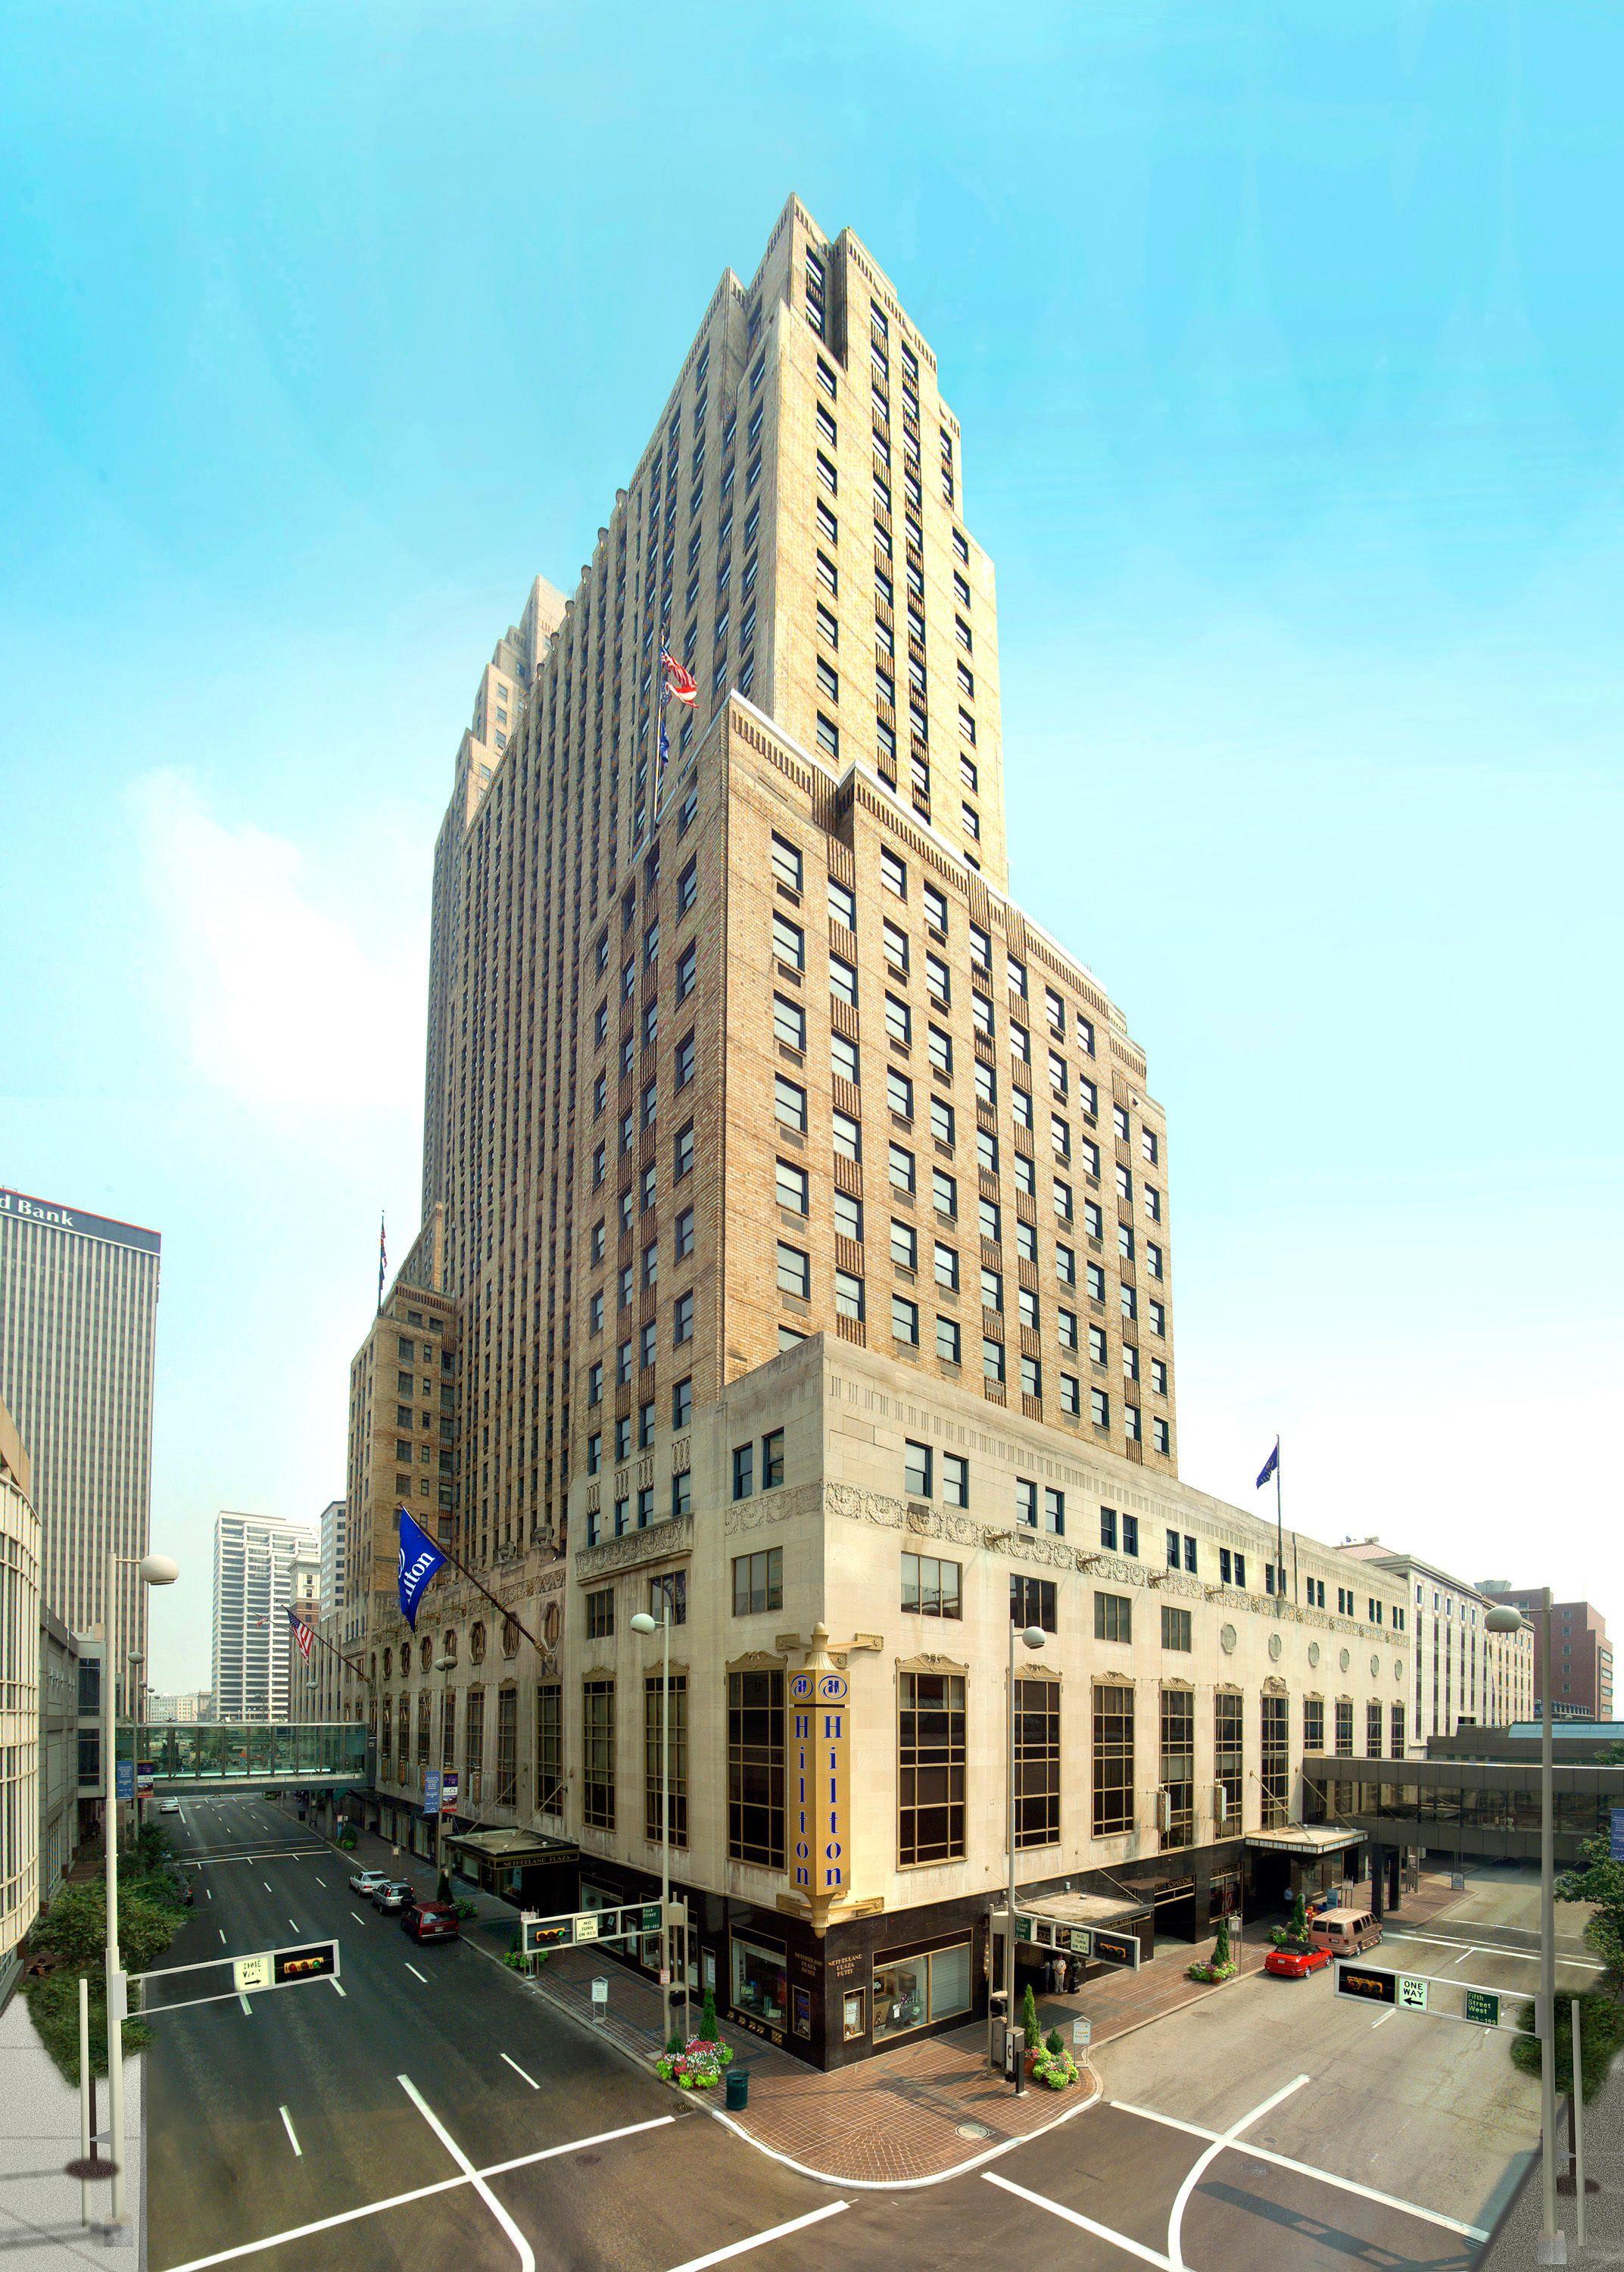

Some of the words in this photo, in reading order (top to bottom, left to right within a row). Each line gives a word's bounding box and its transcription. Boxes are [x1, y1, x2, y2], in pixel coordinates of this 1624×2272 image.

[18, 1199, 73, 1227] Bank
[794, 1715, 811, 1887] Hilton
[823, 1715, 843, 1887] Hilton
[1404, 1980, 1423, 1991] ONE
[1403, 1988, 1423, 1998] WAY
[1468, 1992, 1484, 2001] Fifth
[1467, 1999, 1492, 2009] Street
[1468, 2005, 1488, 2015] West
